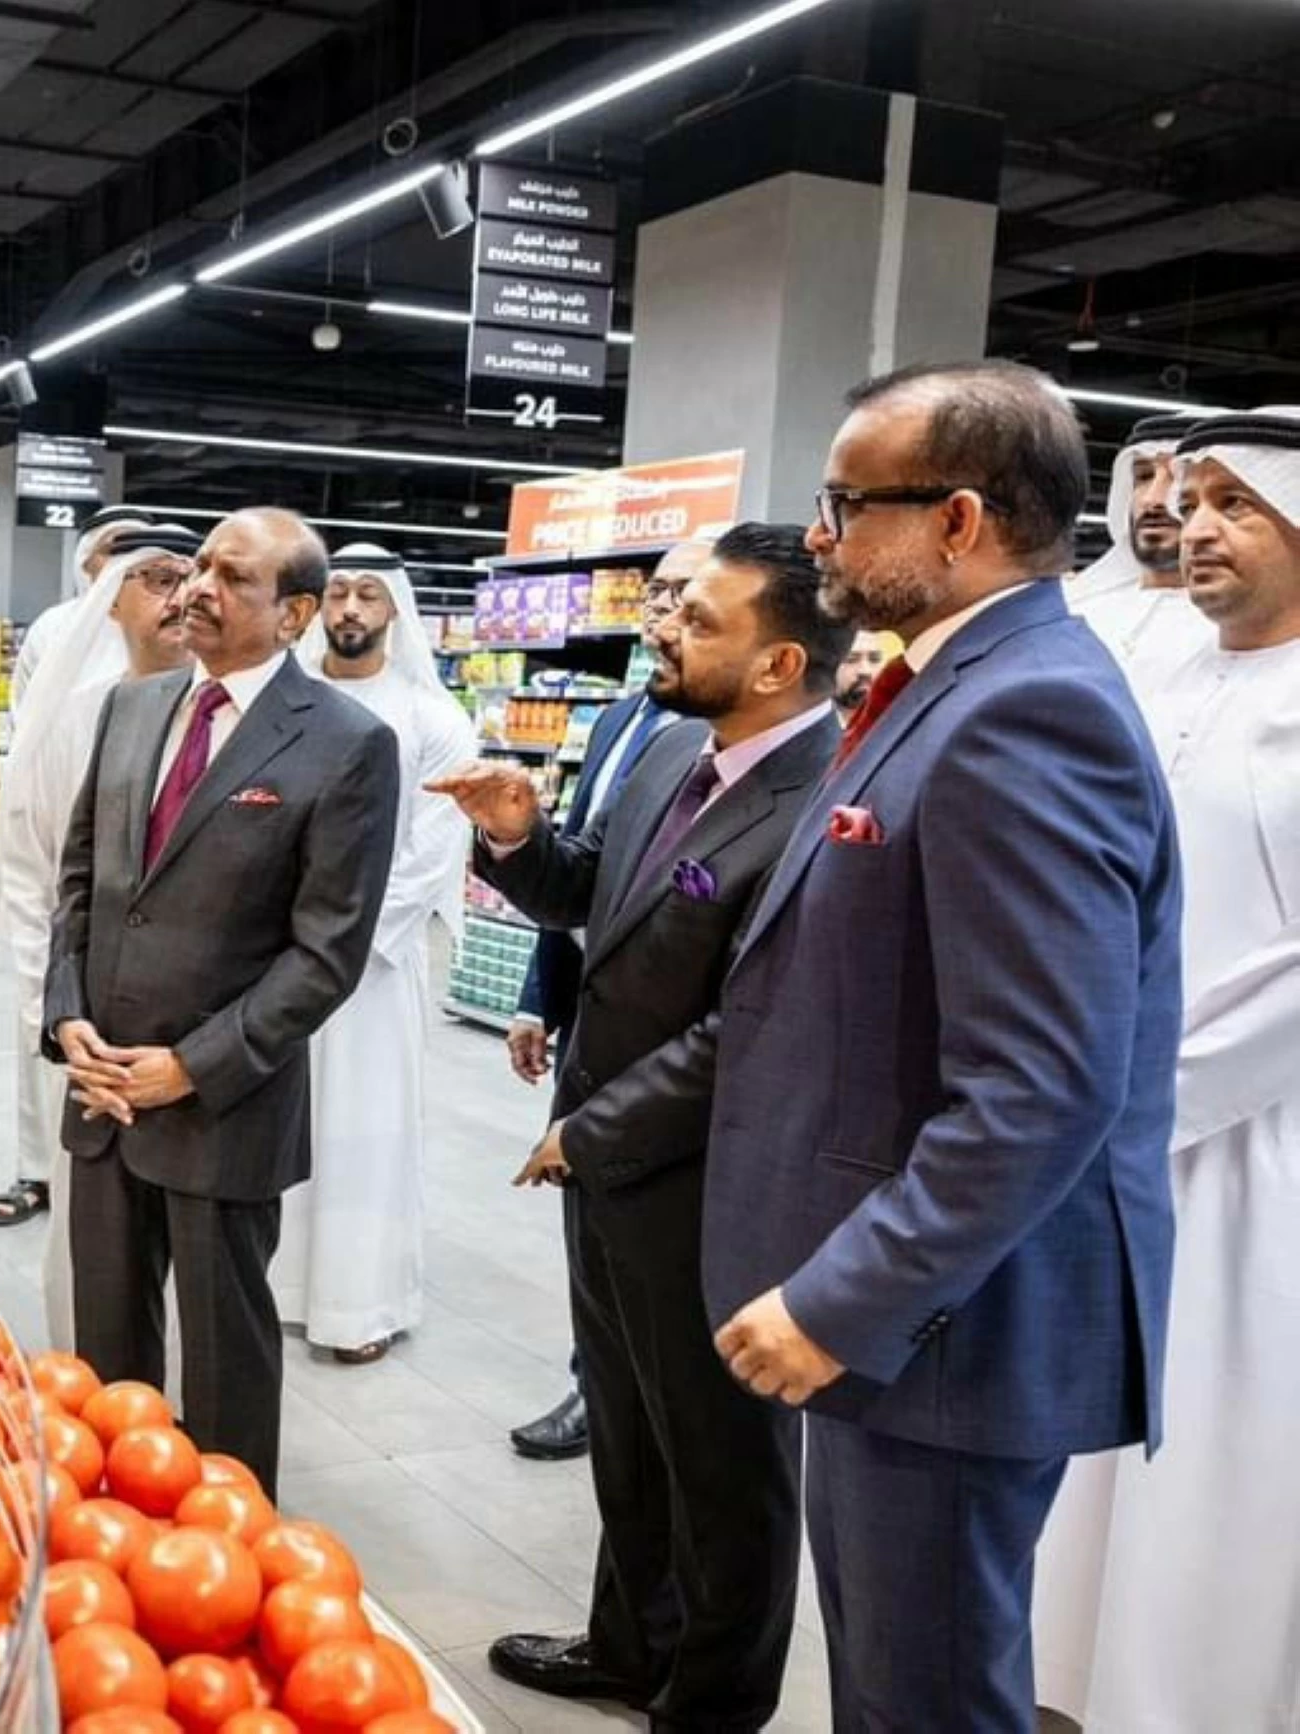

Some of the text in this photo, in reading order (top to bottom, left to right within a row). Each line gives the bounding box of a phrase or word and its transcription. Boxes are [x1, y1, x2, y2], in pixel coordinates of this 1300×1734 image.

[507, 196, 589, 219] MILK POWDER
[488, 247, 602, 273] EVAPORATED MILK
[493, 302, 589, 325] LONG LIFE MILK
[485, 353, 590, 377] FLAVOURED MILK
[513, 394, 556, 429] 24
[45, 504, 76, 528] 22
[588, 506, 689, 547] EDUCED
